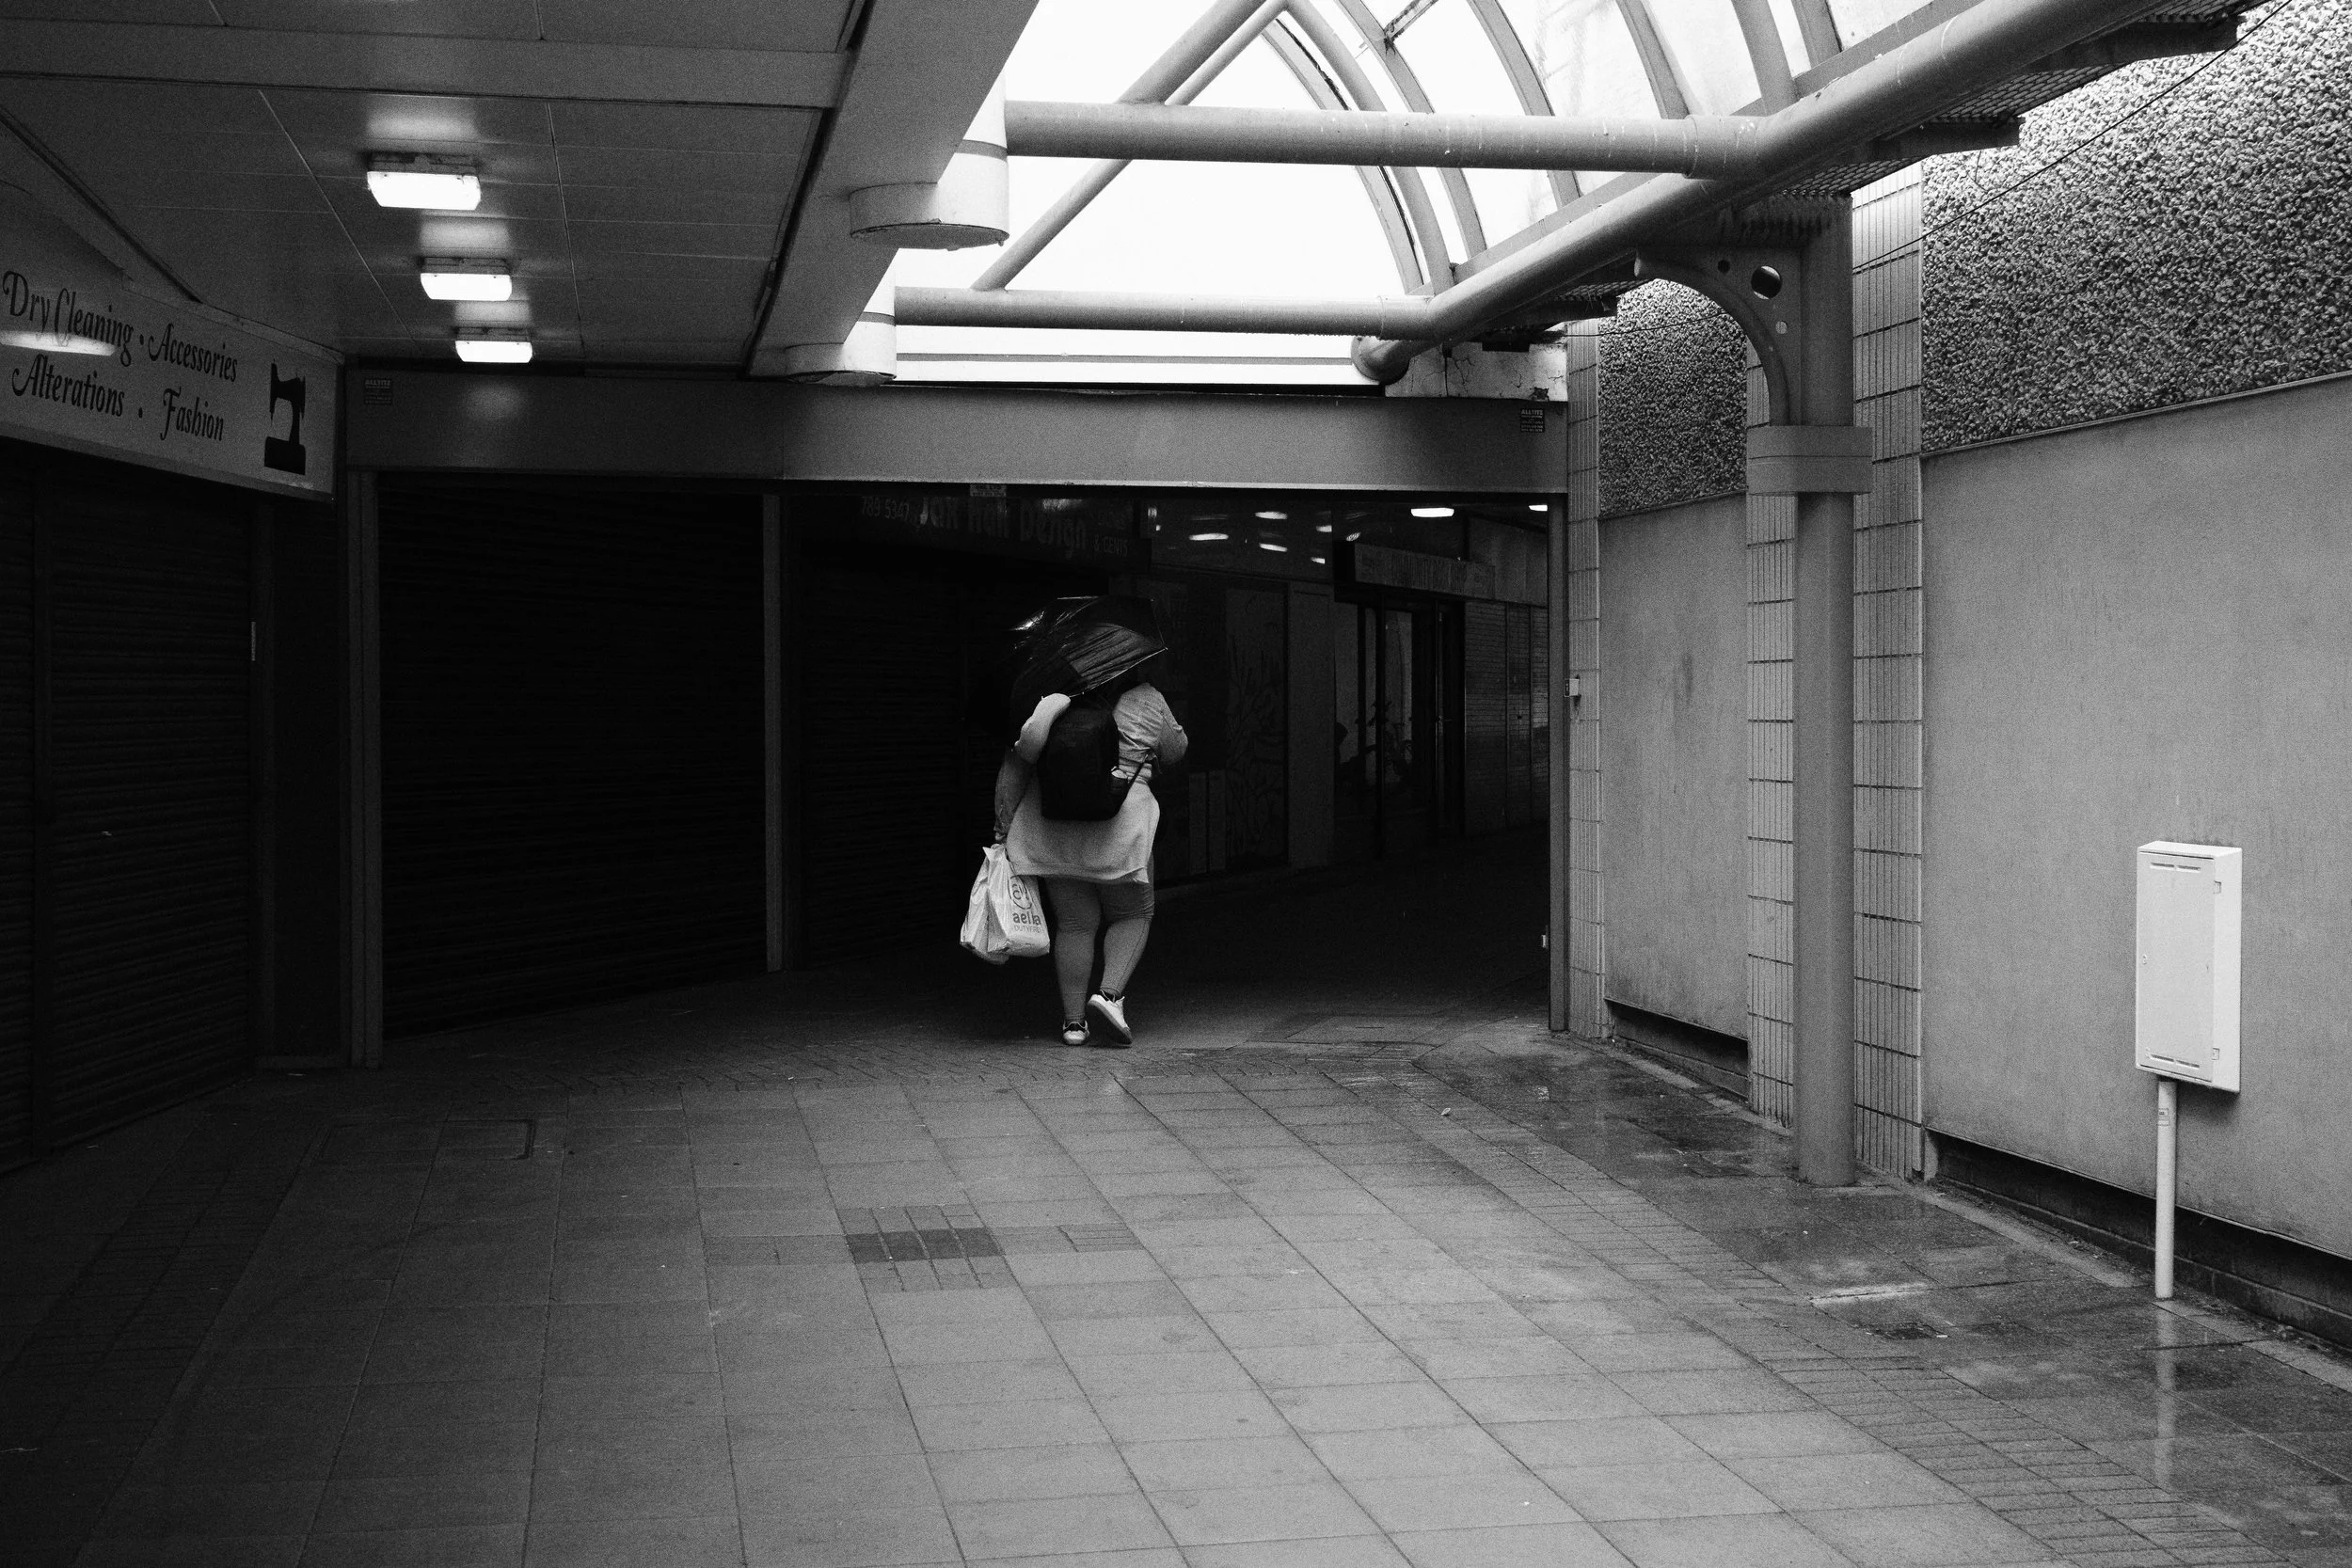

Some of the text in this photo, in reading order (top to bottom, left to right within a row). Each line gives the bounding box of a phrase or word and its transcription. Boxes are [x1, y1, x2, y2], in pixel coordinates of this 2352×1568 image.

[2, 270, 238, 383] Dry Cleaning Accessories
[11, 354, 224, 441] Alterations Fashion
